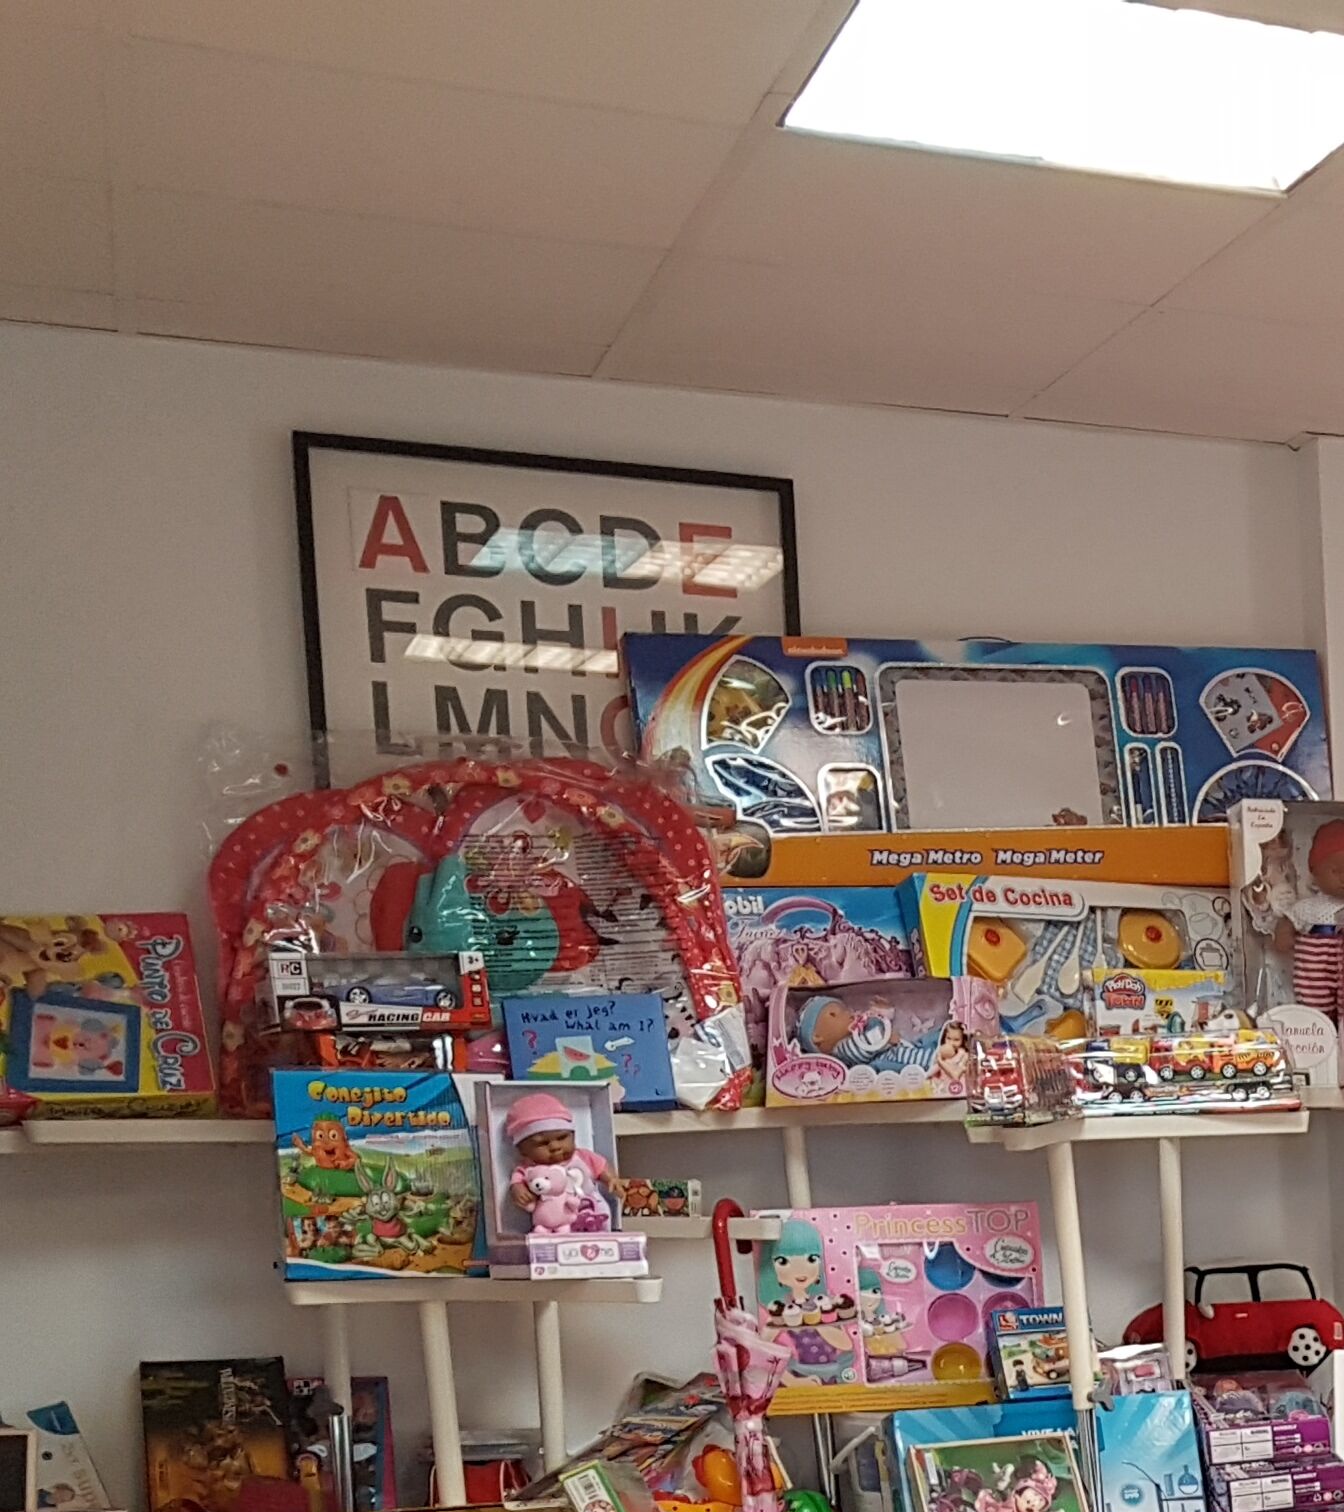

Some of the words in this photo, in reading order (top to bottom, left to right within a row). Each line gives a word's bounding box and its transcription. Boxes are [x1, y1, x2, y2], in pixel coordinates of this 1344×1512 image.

[359, 495, 738, 598] ABCDE
[872, 850, 923, 866] Mega
[927, 850, 983, 864] Metro
[998, 850, 1045, 866] Mega
[1051, 850, 1103, 864] Meter
[725, 895, 764, 916] obil
[930, 884, 967, 903] Set
[973, 886, 997, 904] de
[1003, 887, 1074, 908] Cocina
[368, 1013, 419, 1023] RACING
[1282, 1022, 1324, 1036] anuela
[308, 1080, 408, 1108] Conejito
[346, 1105, 451, 1127] Divertido
[1019, 1311, 1063, 1324] TOWN
